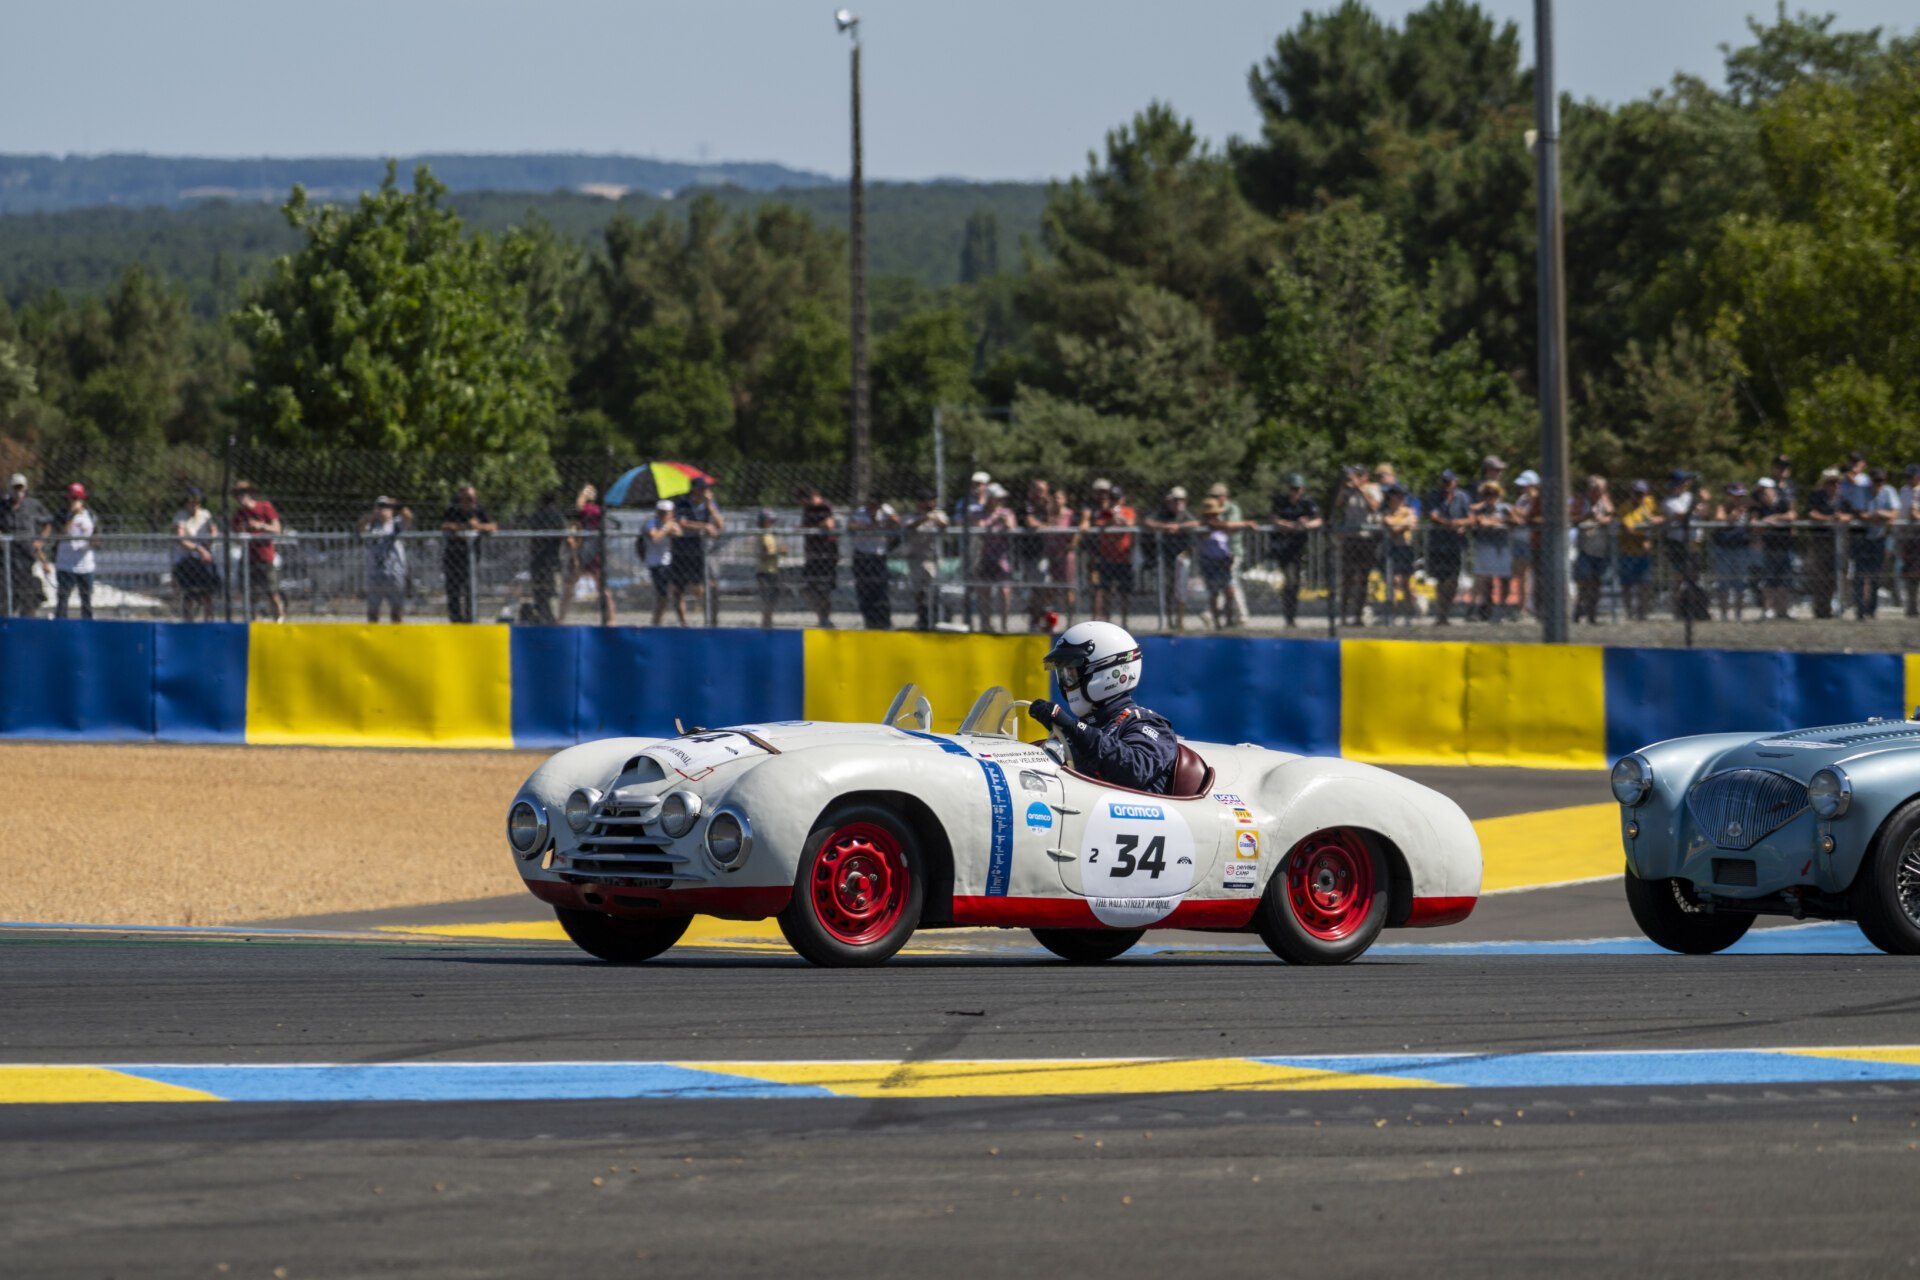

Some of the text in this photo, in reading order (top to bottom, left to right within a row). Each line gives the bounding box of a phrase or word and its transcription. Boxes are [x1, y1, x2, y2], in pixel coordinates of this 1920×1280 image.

[1028, 813, 1051, 821] aramco
[1114, 806, 1159, 818] aramco
[1089, 834, 1166, 879] 2 34
[1095, 899, 1171, 913] THE WALL STREET JOURNAL
